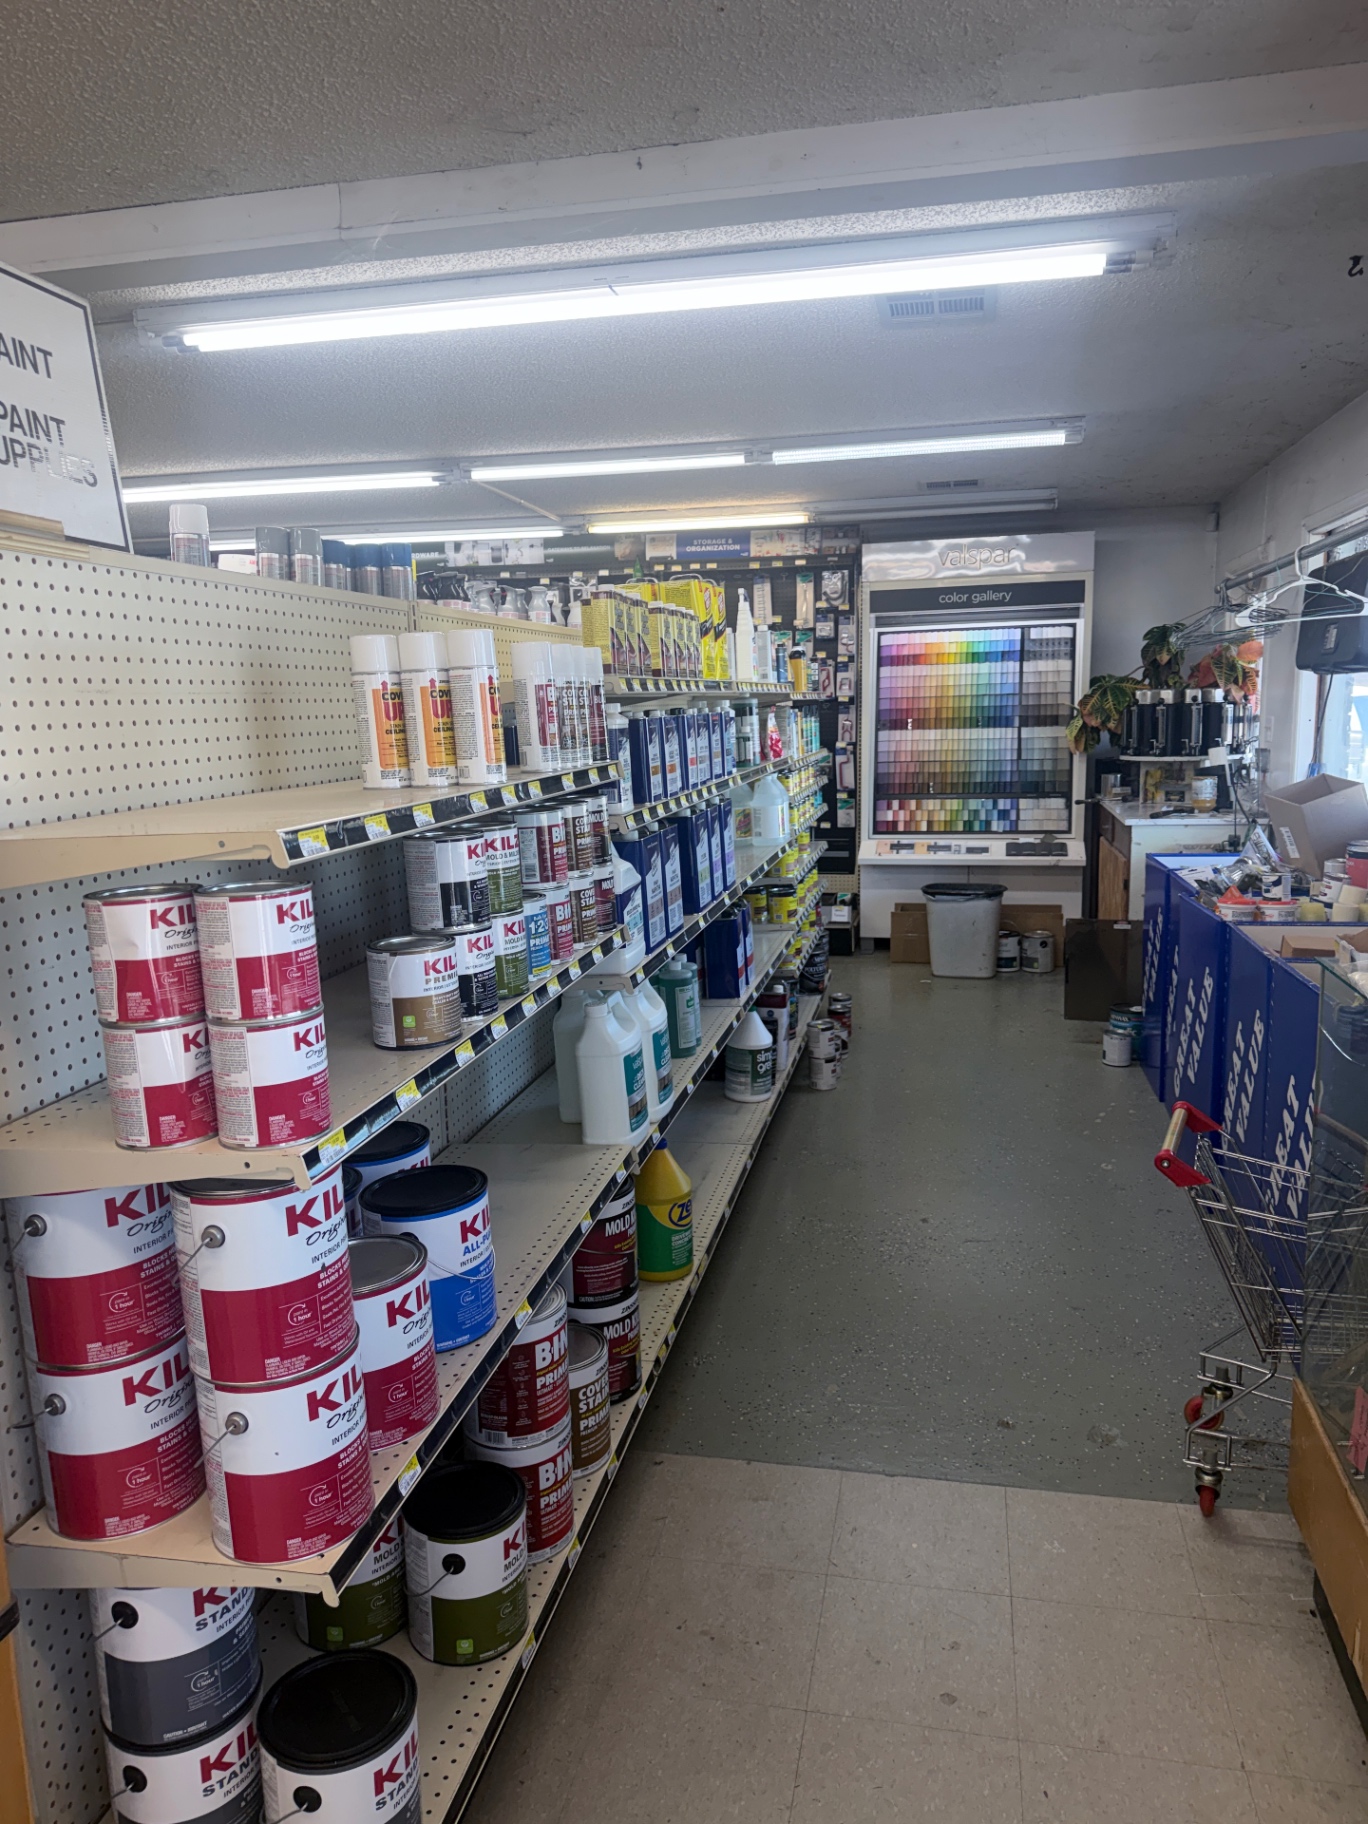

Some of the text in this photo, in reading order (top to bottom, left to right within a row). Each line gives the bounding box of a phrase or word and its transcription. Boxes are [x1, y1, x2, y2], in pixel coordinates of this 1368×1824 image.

[0, 332, 53, 379] AINT
[0, 435, 98, 488] UPPLIES
[686, 544, 740, 552] ORGANIZATION
[938, 544, 1016, 570] valspar
[939, 590, 1012, 604] color gallery
[150, 903, 196, 930] KIL
[276, 898, 314, 925] KIL
[166, 941, 193, 951] INTERIOR
[467, 934, 494, 953] KIL
[424, 955, 457, 976] KIL
[293, 1022, 326, 1051] KIL
[1187, 966, 1213, 1084] VALUE
[1173, 977, 1196, 1098] GREAT
[757, 1051, 772, 1062] sim
[757, 1061, 773, 1074] gre
[1221, 1020, 1245, 1151] GREAT
[1236, 1009, 1265, 1144] VALUE
[104, 1183, 171, 1228] KIL
[285, 1184, 344, 1237] KIL
[677, 1198, 692, 1222] Ze
[460, 1204, 490, 1244] KIL
[605, 1214, 631, 1238] MOLD
[133, 1233, 167, 1254] INTERIOR
[311, 1242, 341, 1264] INTERIOR
[462, 1233, 492, 1256] ALL-PU
[140, 1262, 166, 1279] STAINS
[143, 1251, 168, 1269] BLOCKS
[319, 1260, 342, 1279] BLOCKS
[460, 1250, 484, 1267] INTERIOR
[317, 1272, 339, 1289] STAINS
[119, 1300, 134, 1309] hour
[386, 1279, 430, 1328] KIL
[298, 1312, 312, 1321] hour
[407, 1328, 429, 1349] INTERIOR
[603, 1317, 631, 1341] MOLD
[264, 1356, 281, 1364] DANGER
[122, 1351, 190, 1407] KIL
[537, 1360, 568, 1389] PRIM
[306, 1364, 362, 1421] KIL
[150, 1405, 184, 1430] INTERIOR
[159, 1425, 186, 1444] BLOCKS
[331, 1418, 359, 1445] INTERIOR
[157, 1436, 183, 1453] STAINS
[339, 1437, 361, 1460] BLOCKS
[337, 1451, 356, 1469] STAINS
[137, 1474, 151, 1483] hour
[319, 1492, 332, 1501] hour
[540, 1476, 573, 1509] PRIM
[371, 1555, 398, 1575] INTERIOR
[373, 1542, 400, 1565] MOLD
[504, 1549, 525, 1573] MOLD
[195, 1587, 250, 1632] STAND
[216, 1605, 246, 1633] INTERIOR
[200, 1721, 258, 1784] KIL
[374, 1731, 419, 1797] KIL
[203, 1747, 258, 1797] STAND
[223, 1768, 253, 1798] INTERIOR
[375, 1757, 418, 1811] STAND
